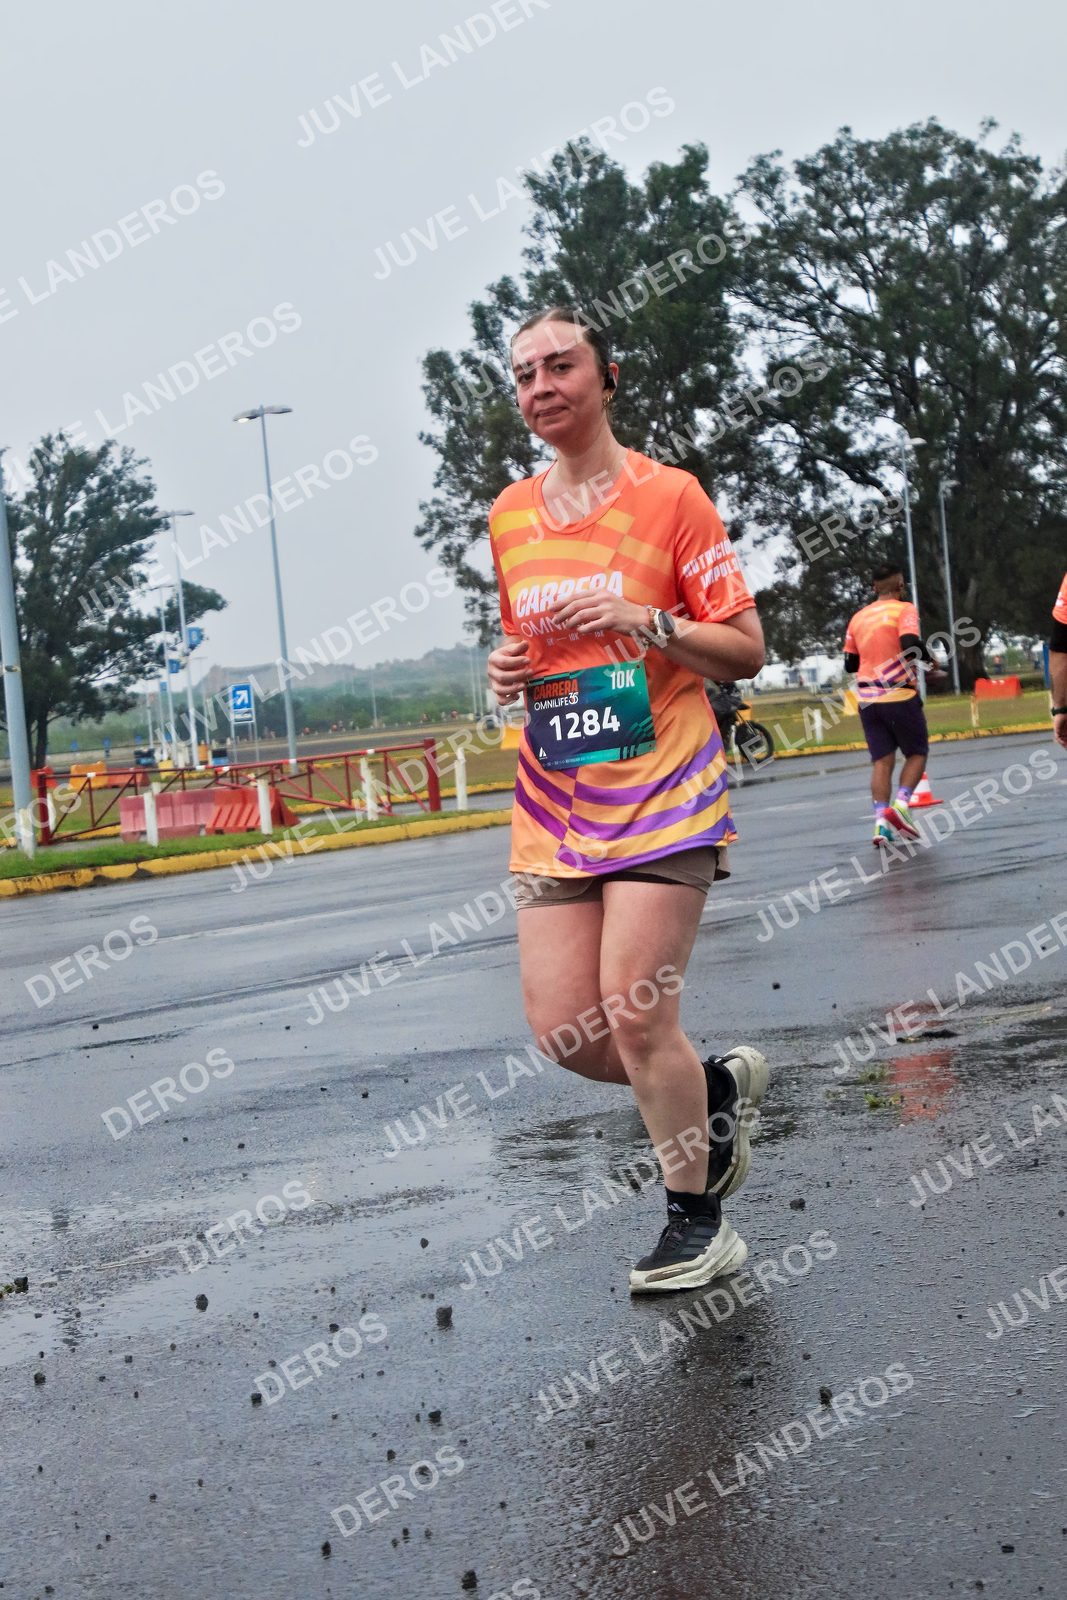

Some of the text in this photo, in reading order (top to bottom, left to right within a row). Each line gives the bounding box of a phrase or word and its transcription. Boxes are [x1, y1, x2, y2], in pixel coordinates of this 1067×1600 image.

[534, 679, 579, 700] CARRERA
[611, 668, 636, 690] 10K
[549, 706, 621, 741] 1284
